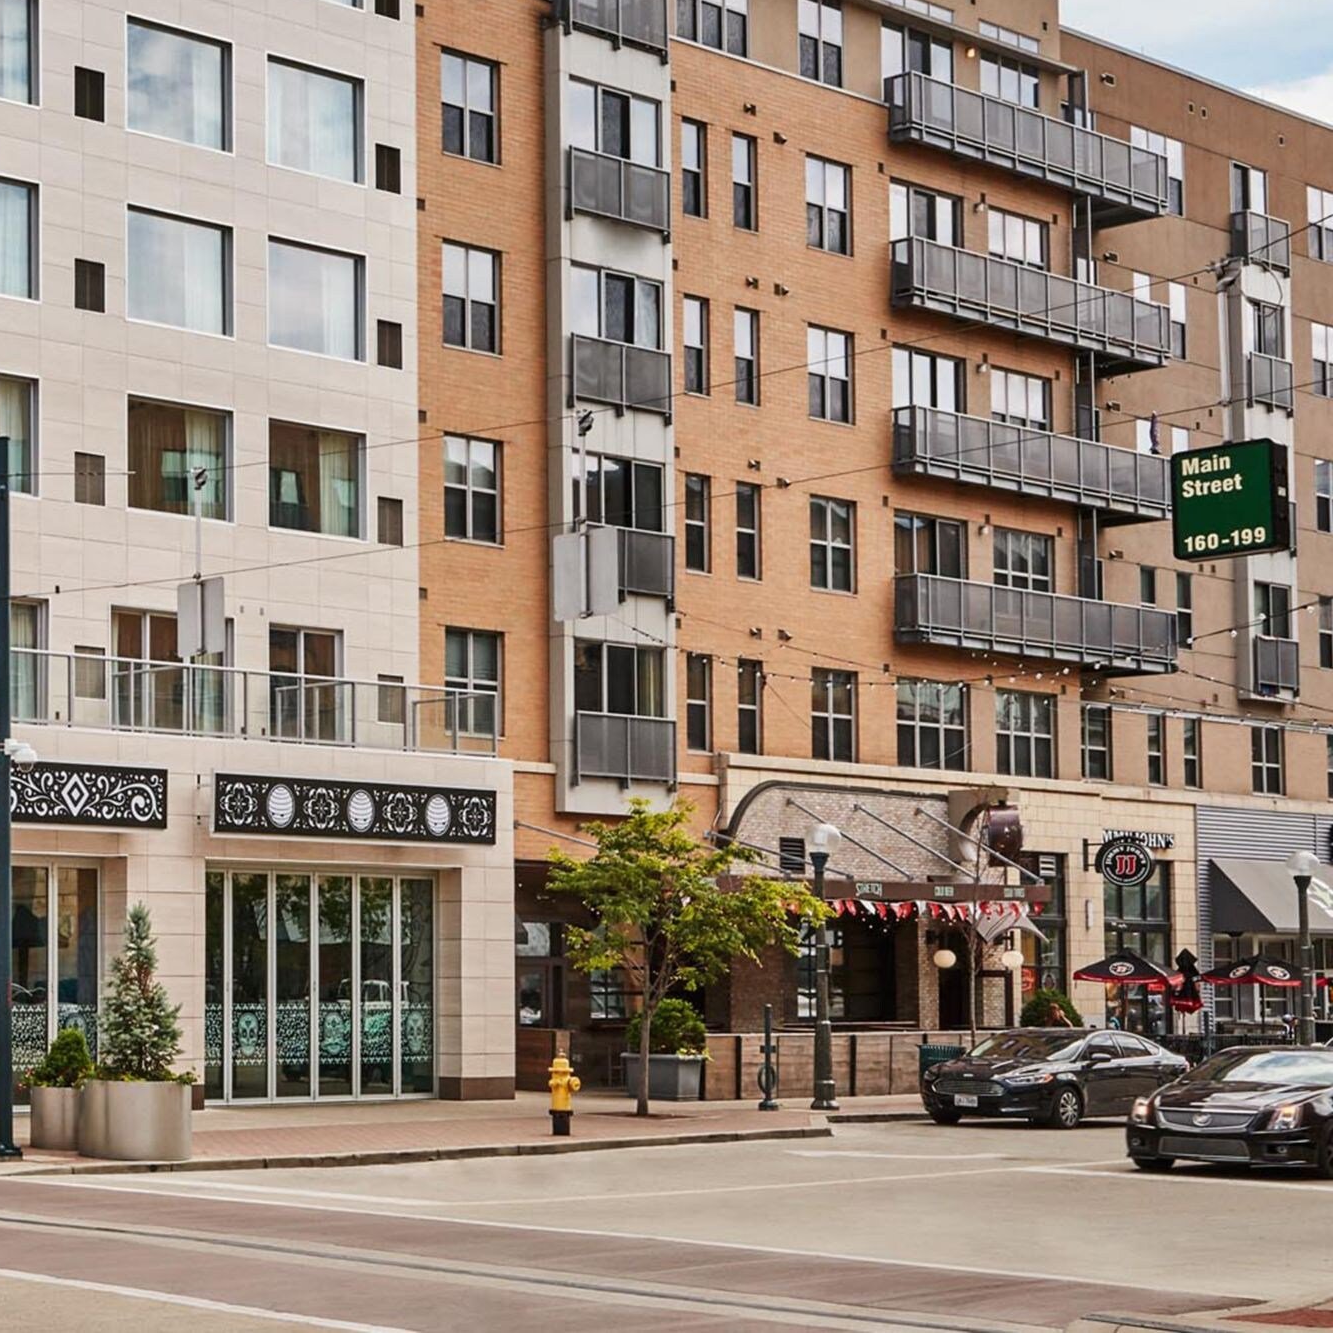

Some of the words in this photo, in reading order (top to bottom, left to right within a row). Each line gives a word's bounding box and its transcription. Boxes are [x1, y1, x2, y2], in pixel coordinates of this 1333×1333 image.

[1181, 454, 1231, 476] Main
[1182, 473, 1243, 498] Street
[1184, 527, 1266, 552] 160-199
[1116, 855, 1136, 875] JJ
